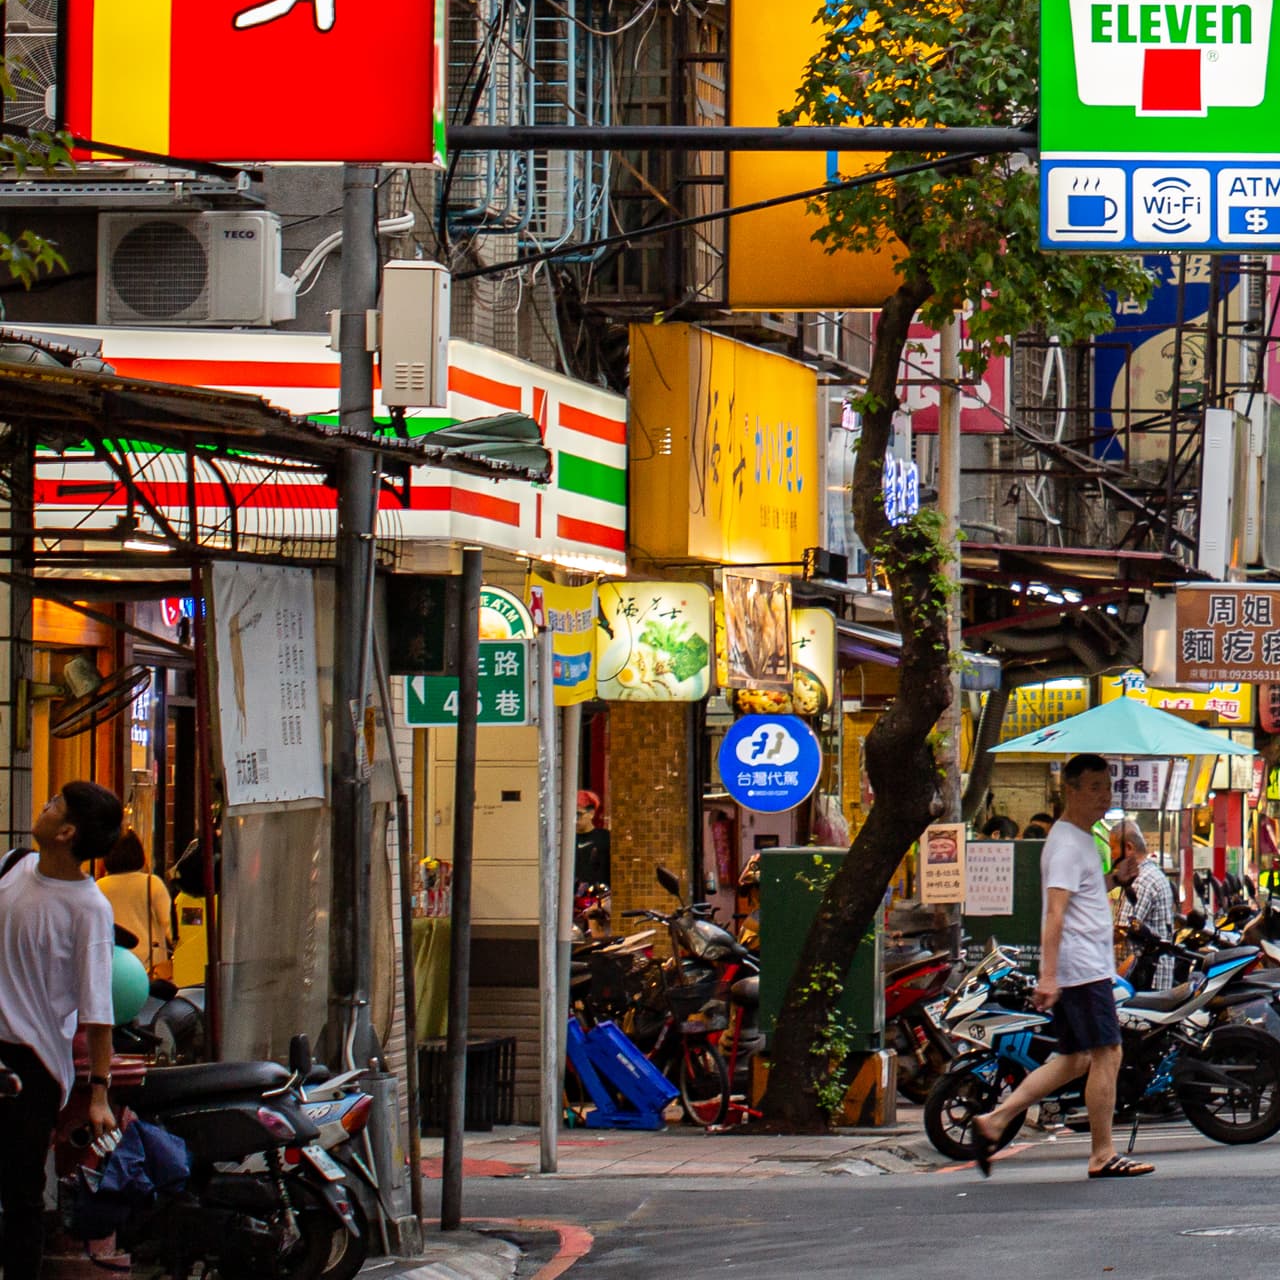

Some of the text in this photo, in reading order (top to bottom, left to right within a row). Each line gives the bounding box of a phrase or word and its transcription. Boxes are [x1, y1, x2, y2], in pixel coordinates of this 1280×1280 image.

[1143, 197, 1201, 216] Wi-Fi
[223, 229, 255, 240] TECO
[1208, 594, 1273, 627] 周姐
[738, 771, 799, 786] 台灣代駕
